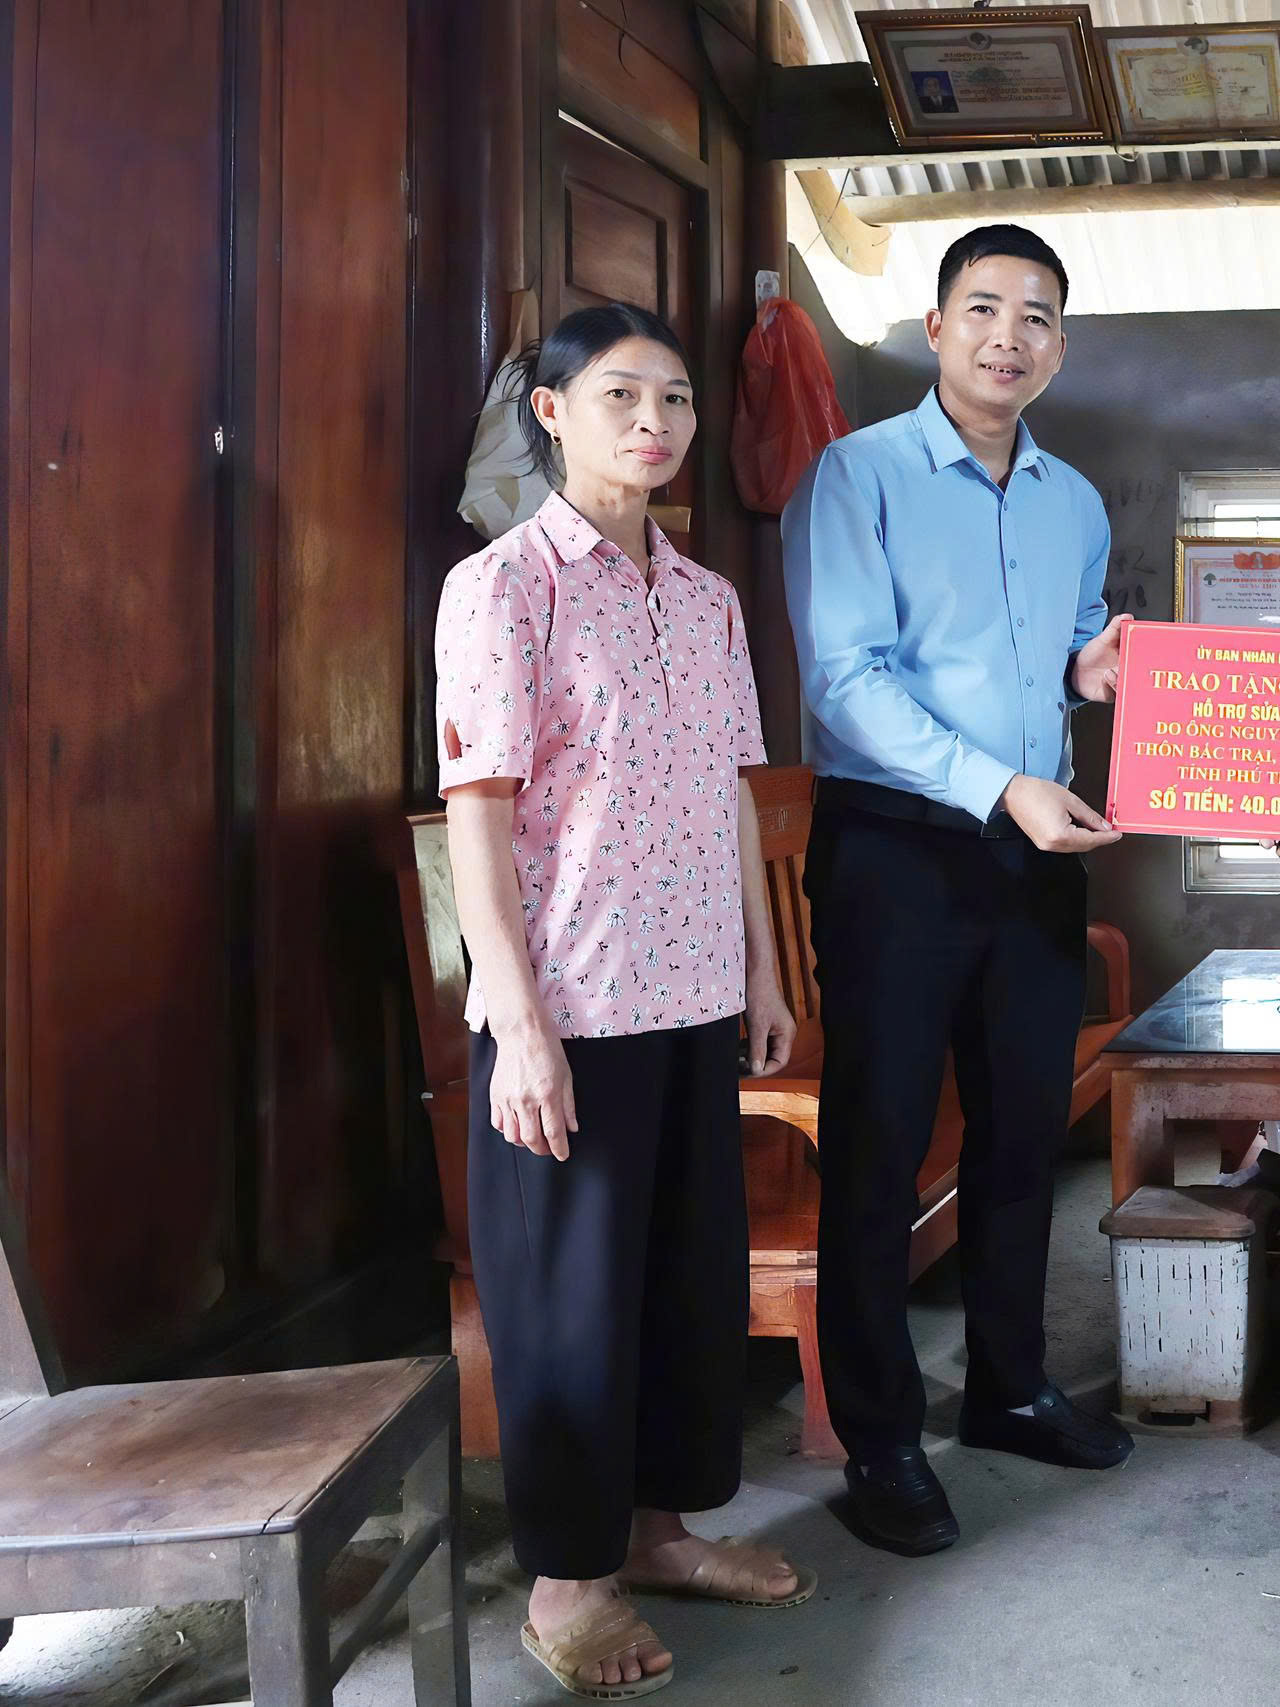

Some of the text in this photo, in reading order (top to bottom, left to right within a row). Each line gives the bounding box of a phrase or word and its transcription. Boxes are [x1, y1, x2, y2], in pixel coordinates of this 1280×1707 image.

[1215, 650, 1239, 662] BAN
[1243, 650, 1275, 664] NHÂN
[1150, 670, 1221, 692] TRAO
[1218, 703, 1247, 723] TRỢ
[1251, 701, 1280, 722] SỬA
[1156, 721, 1182, 736] DO
[1186, 719, 1225, 738] ÔNG
[1134, 739, 1184, 758] THÔN
[1226, 765, 1262, 785] PHÚ
[1149, 784, 1178, 811] SỐ
